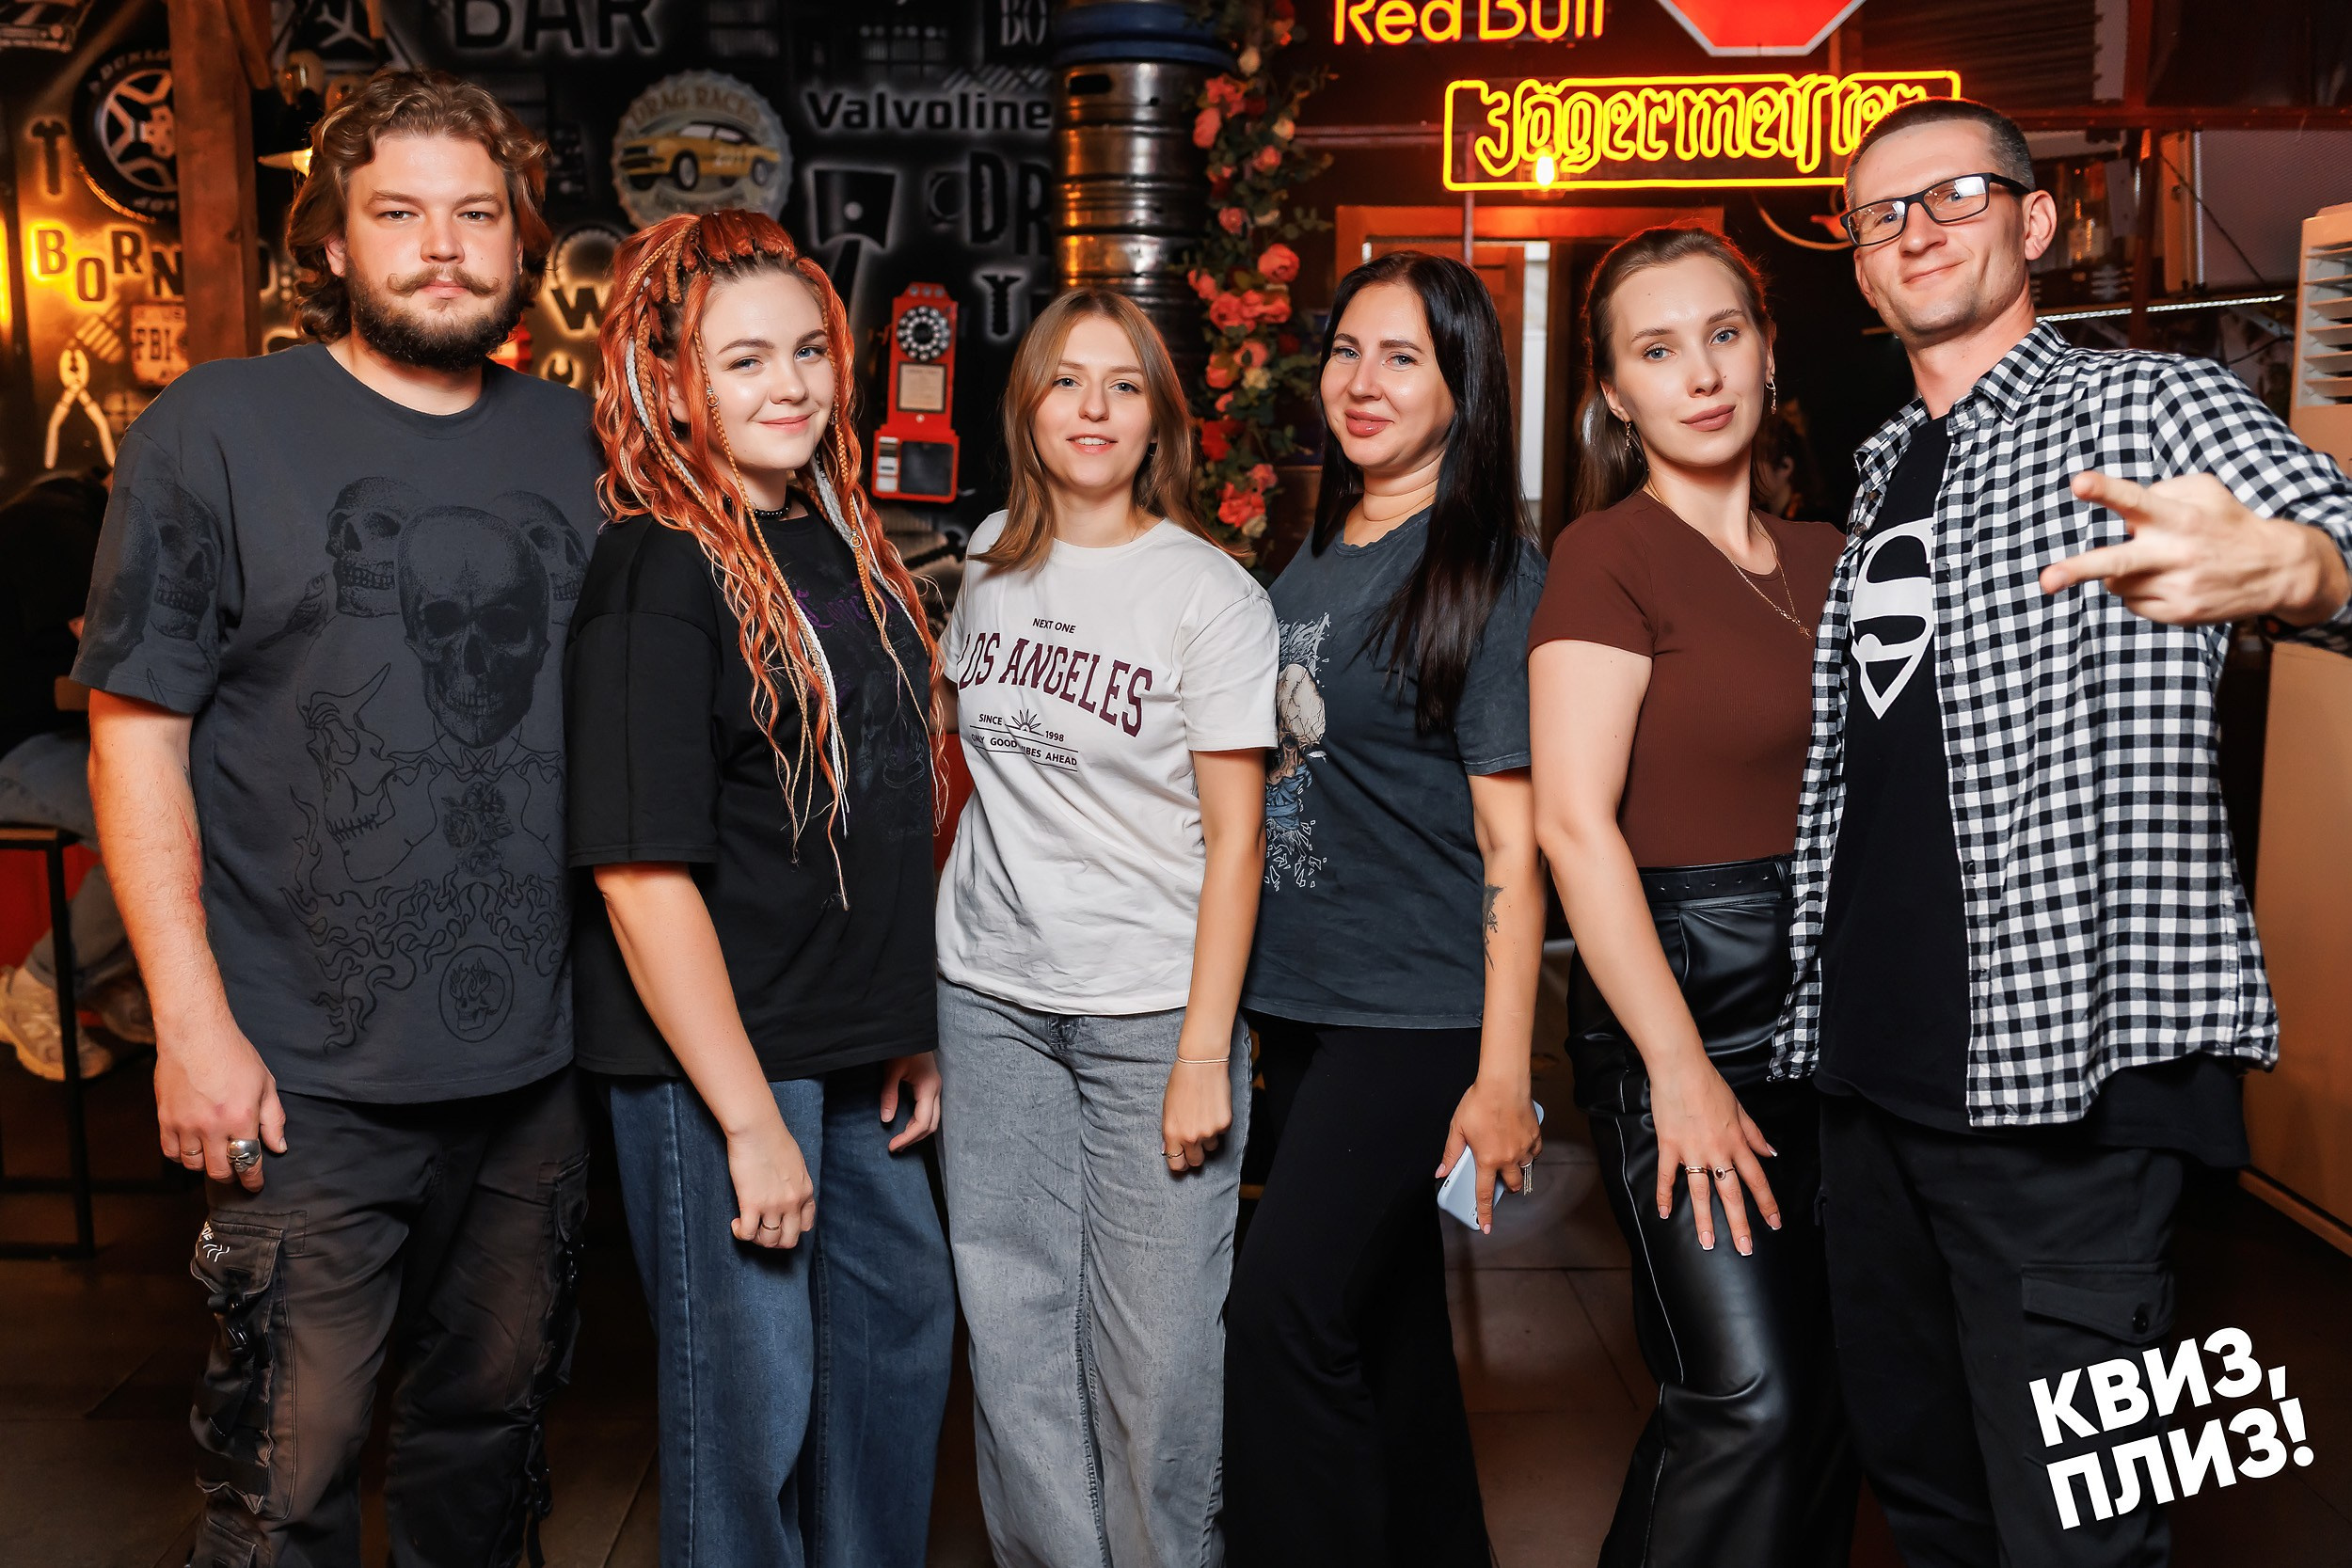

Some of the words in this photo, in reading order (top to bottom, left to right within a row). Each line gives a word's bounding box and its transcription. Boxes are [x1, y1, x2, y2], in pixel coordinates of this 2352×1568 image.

[1332, 0, 1463, 45] Red
[1477, 0, 1605, 41] Bull
[806, 92, 1051, 130] Valvoline
[1473, 73, 1929, 177] Jägermeiste
[38, 230, 183, 302] BORN
[1033, 618, 1054, 629] NEXT
[1055, 622, 1076, 634] ONE
[998, 638, 1152, 737] ANGELES
[978, 713, 1003, 726] SINCE
[1045, 730, 1065, 742] 1998
[990, 737, 1018, 748] GOOD
[1045, 752, 1077, 766] AHEAD
